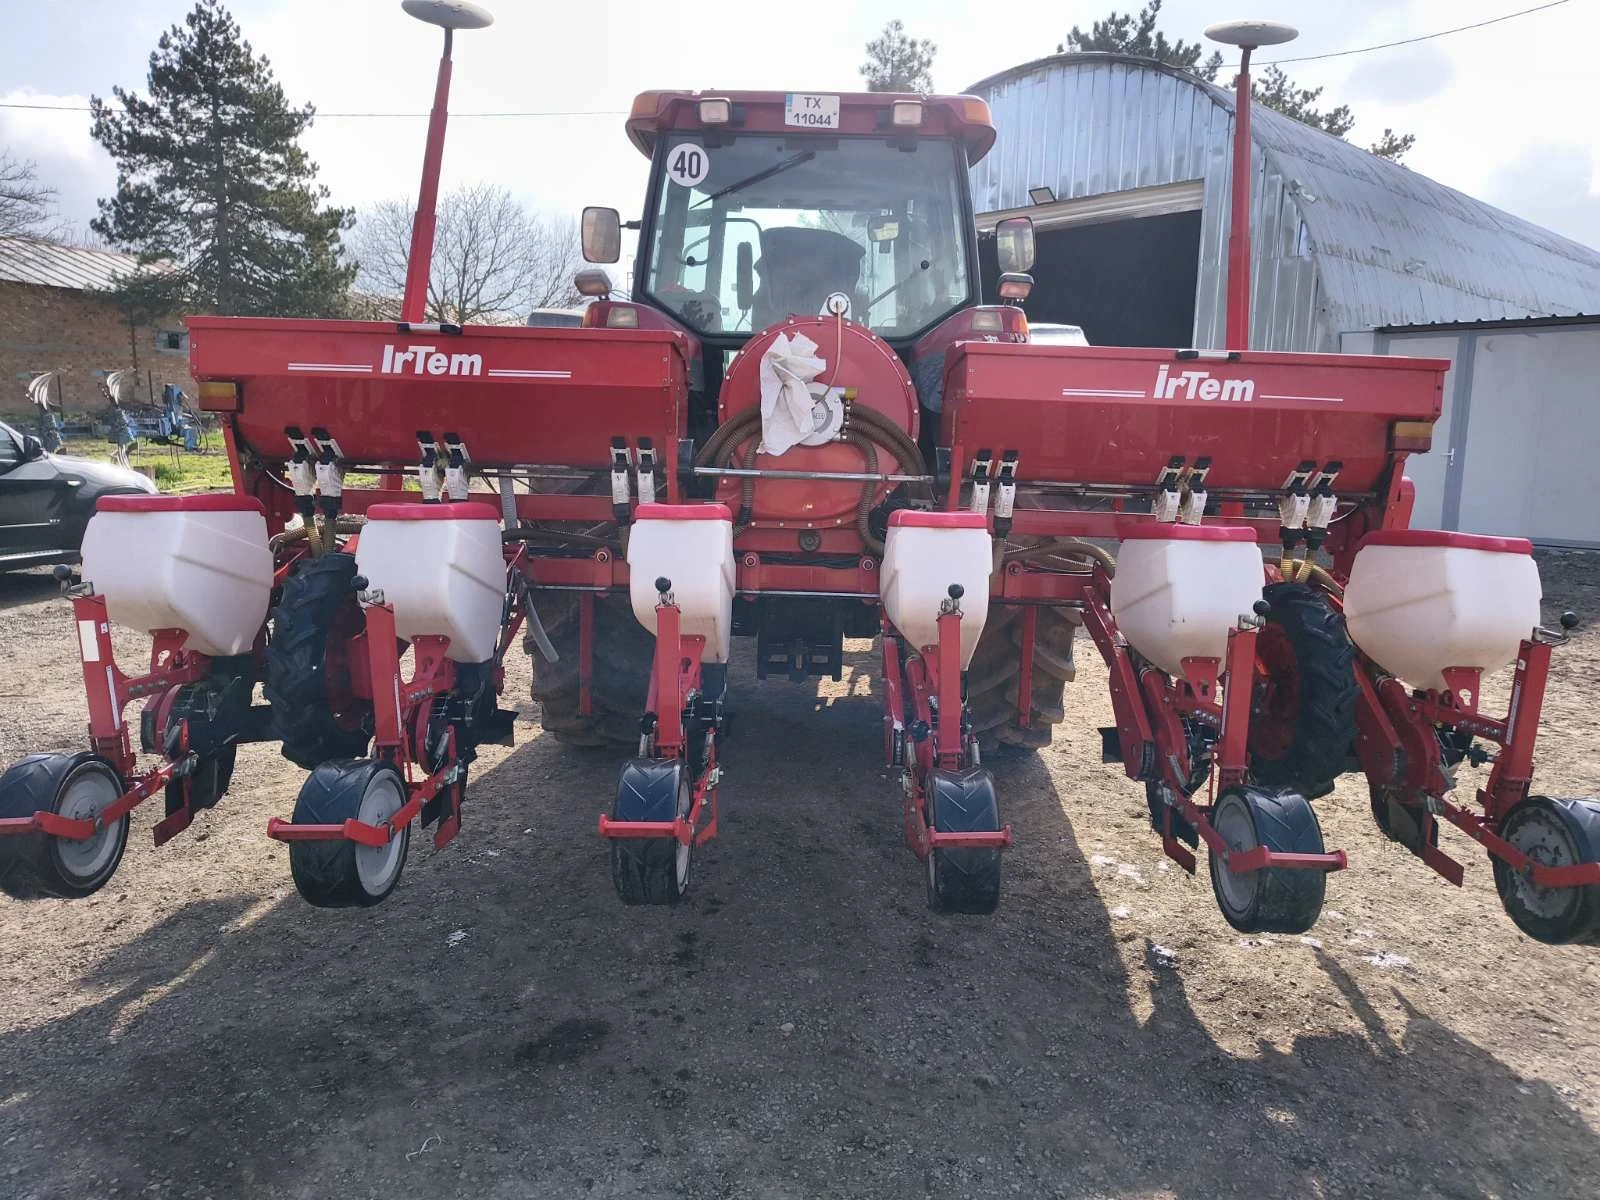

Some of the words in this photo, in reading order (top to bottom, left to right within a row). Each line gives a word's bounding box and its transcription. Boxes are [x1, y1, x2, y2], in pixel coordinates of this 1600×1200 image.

[803, 96, 822, 109] TX
[793, 112, 832, 127] 11044
[672, 150, 702, 179] 40
[381, 344, 483, 376] IrTem
